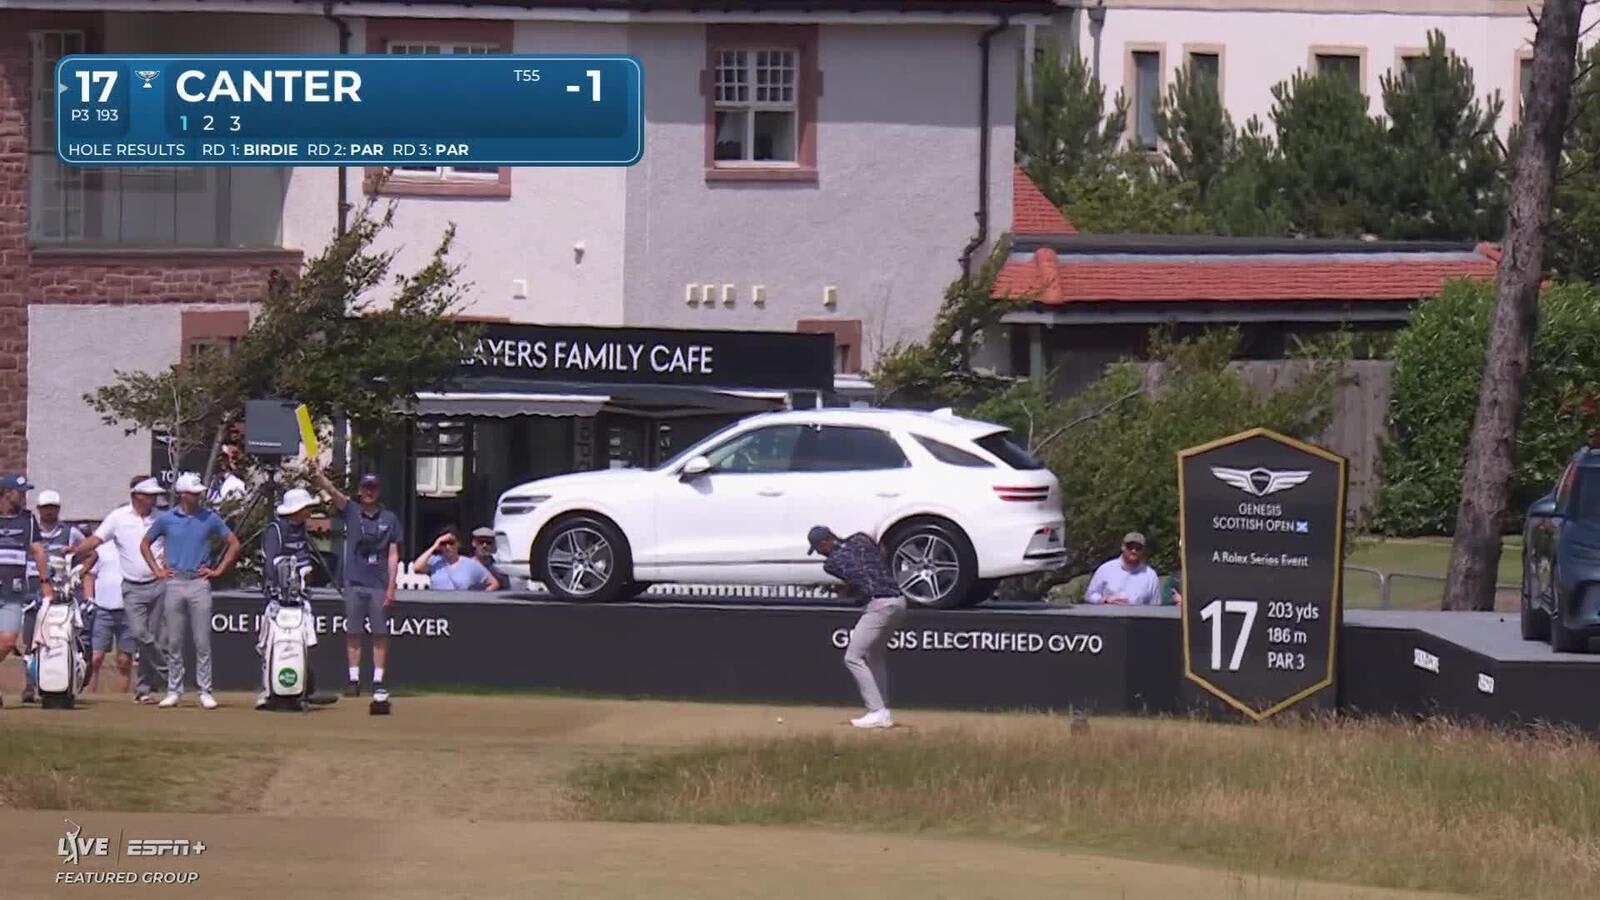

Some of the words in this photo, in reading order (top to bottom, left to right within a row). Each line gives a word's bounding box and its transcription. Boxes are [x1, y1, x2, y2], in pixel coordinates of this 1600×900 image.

[457, 338, 547, 369] LAYERS
[553, 341, 644, 371] FAMILY
[650, 344, 713, 374] CAFE
[1238, 502, 1282, 517] GENESIS
[1212, 516, 1263, 531] SCOTTISH
[1266, 519, 1295, 532] OPEN
[1212, 550, 1221, 563] A
[1222, 551, 1248, 564] Rolex
[1250, 552, 1279, 566] Series
[1281, 553, 1309, 568] Event
[1267, 601, 1293, 619] 203
[1295, 602, 1320, 623] yds
[211, 613, 249, 632] OLE
[385, 617, 450, 636] LAYER
[832, 629, 918, 650] GSIS
[922, 631, 1043, 652] ELECTRIFIED
[1048, 635, 1102, 653] GV70
[1199, 599, 1258, 671] 17
[1267, 627, 1291, 643] 186
[1293, 630, 1308, 644] m
[1267, 651, 1294, 669] PAR
[1296, 653, 1305, 670] 3
